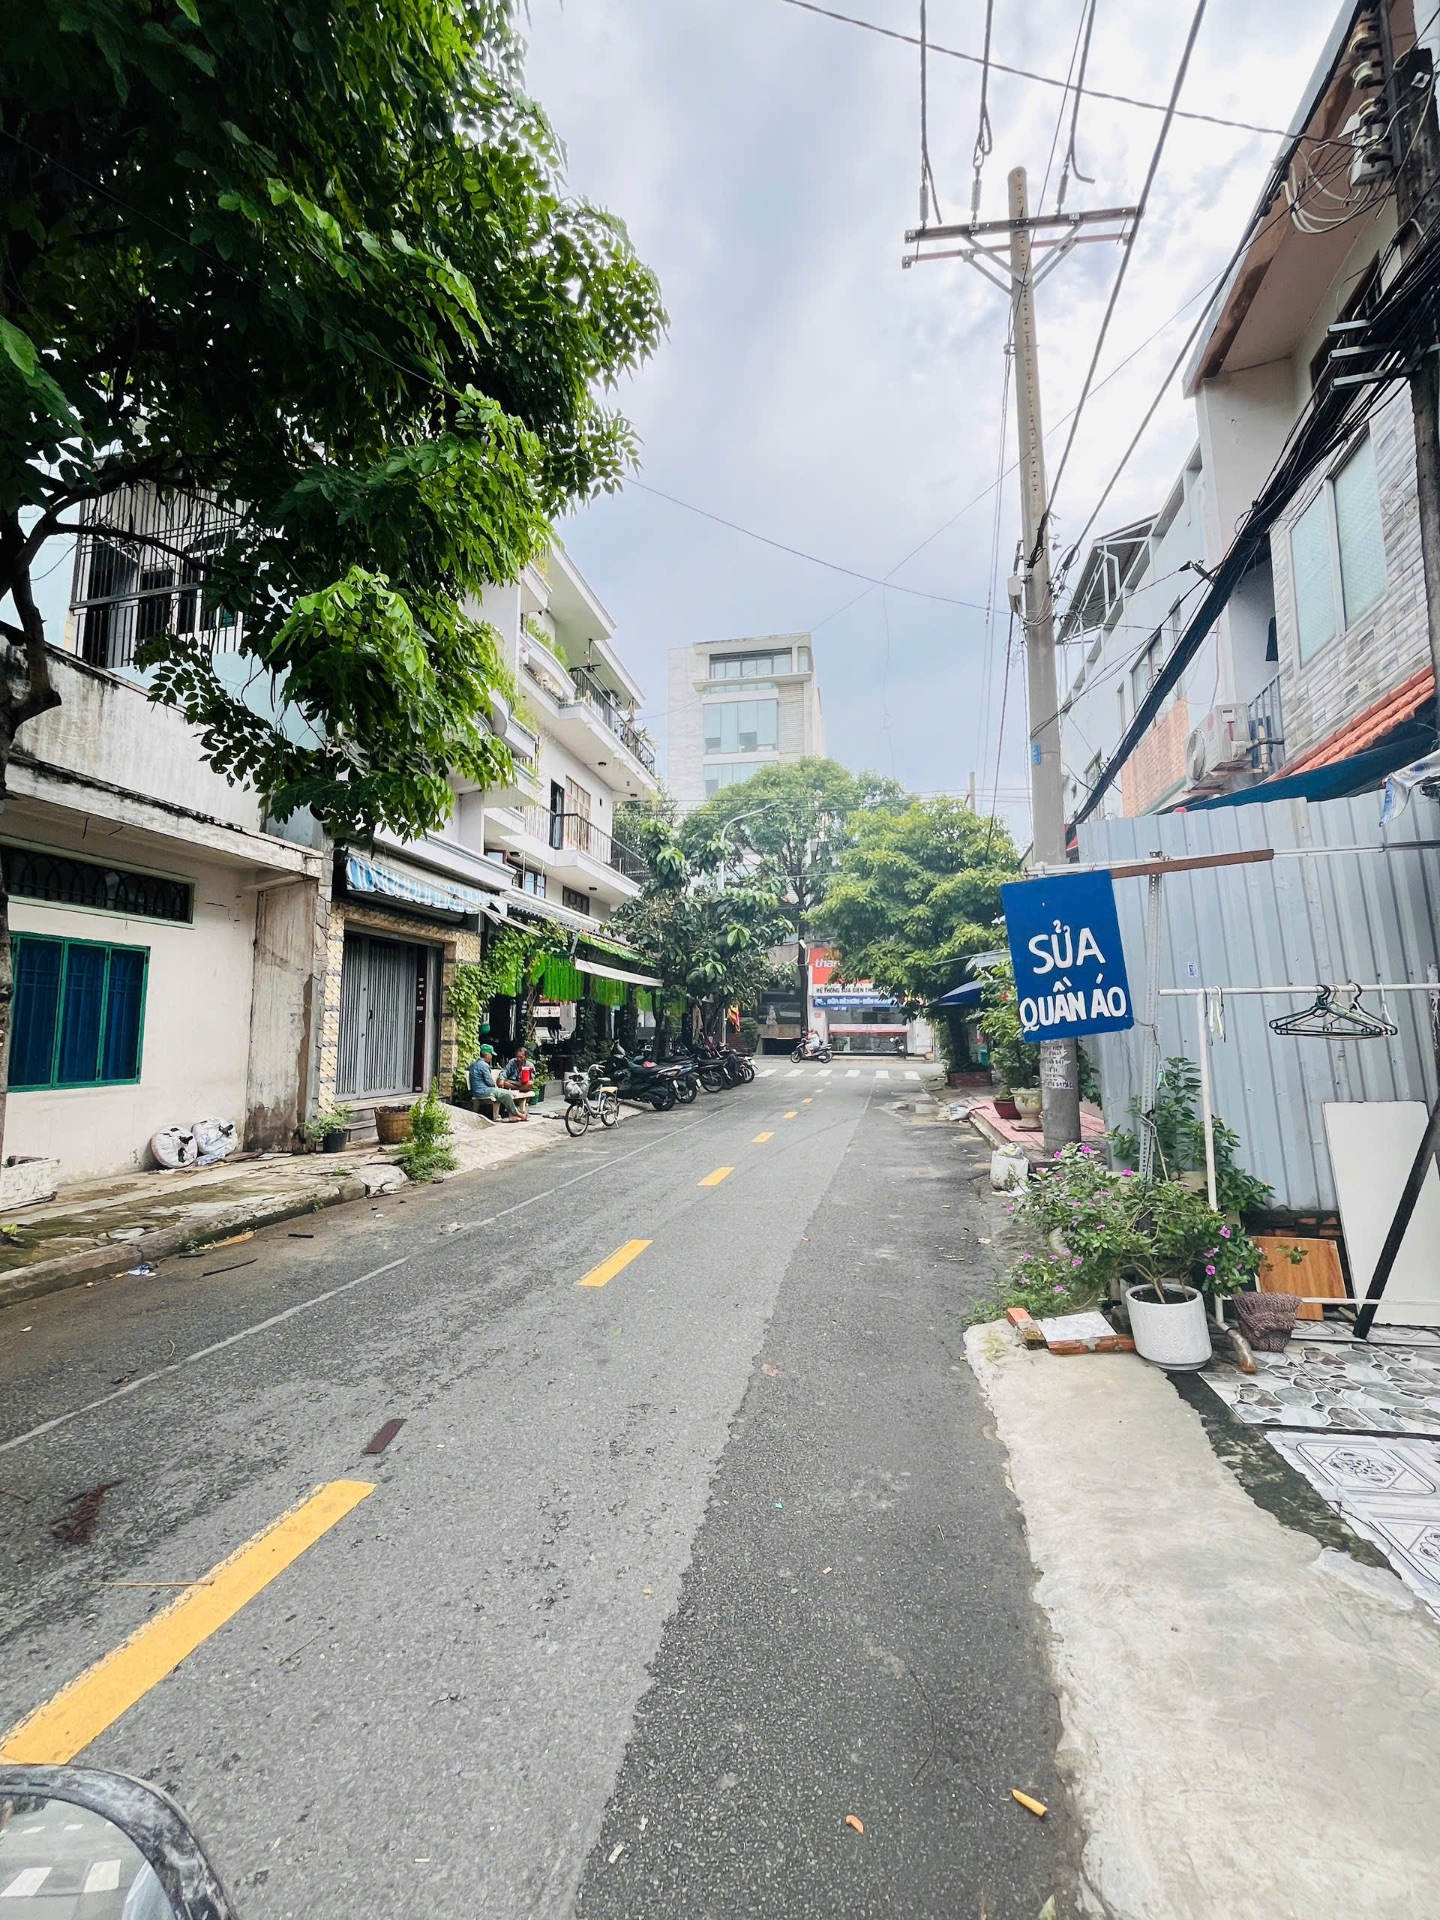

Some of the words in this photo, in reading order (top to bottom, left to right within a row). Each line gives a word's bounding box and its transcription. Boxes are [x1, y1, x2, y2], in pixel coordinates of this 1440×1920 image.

[1028, 919, 1106, 974] SỬA
[1019, 976, 1087, 1031] QUẦN
[1091, 973, 1127, 1018] ÁO
